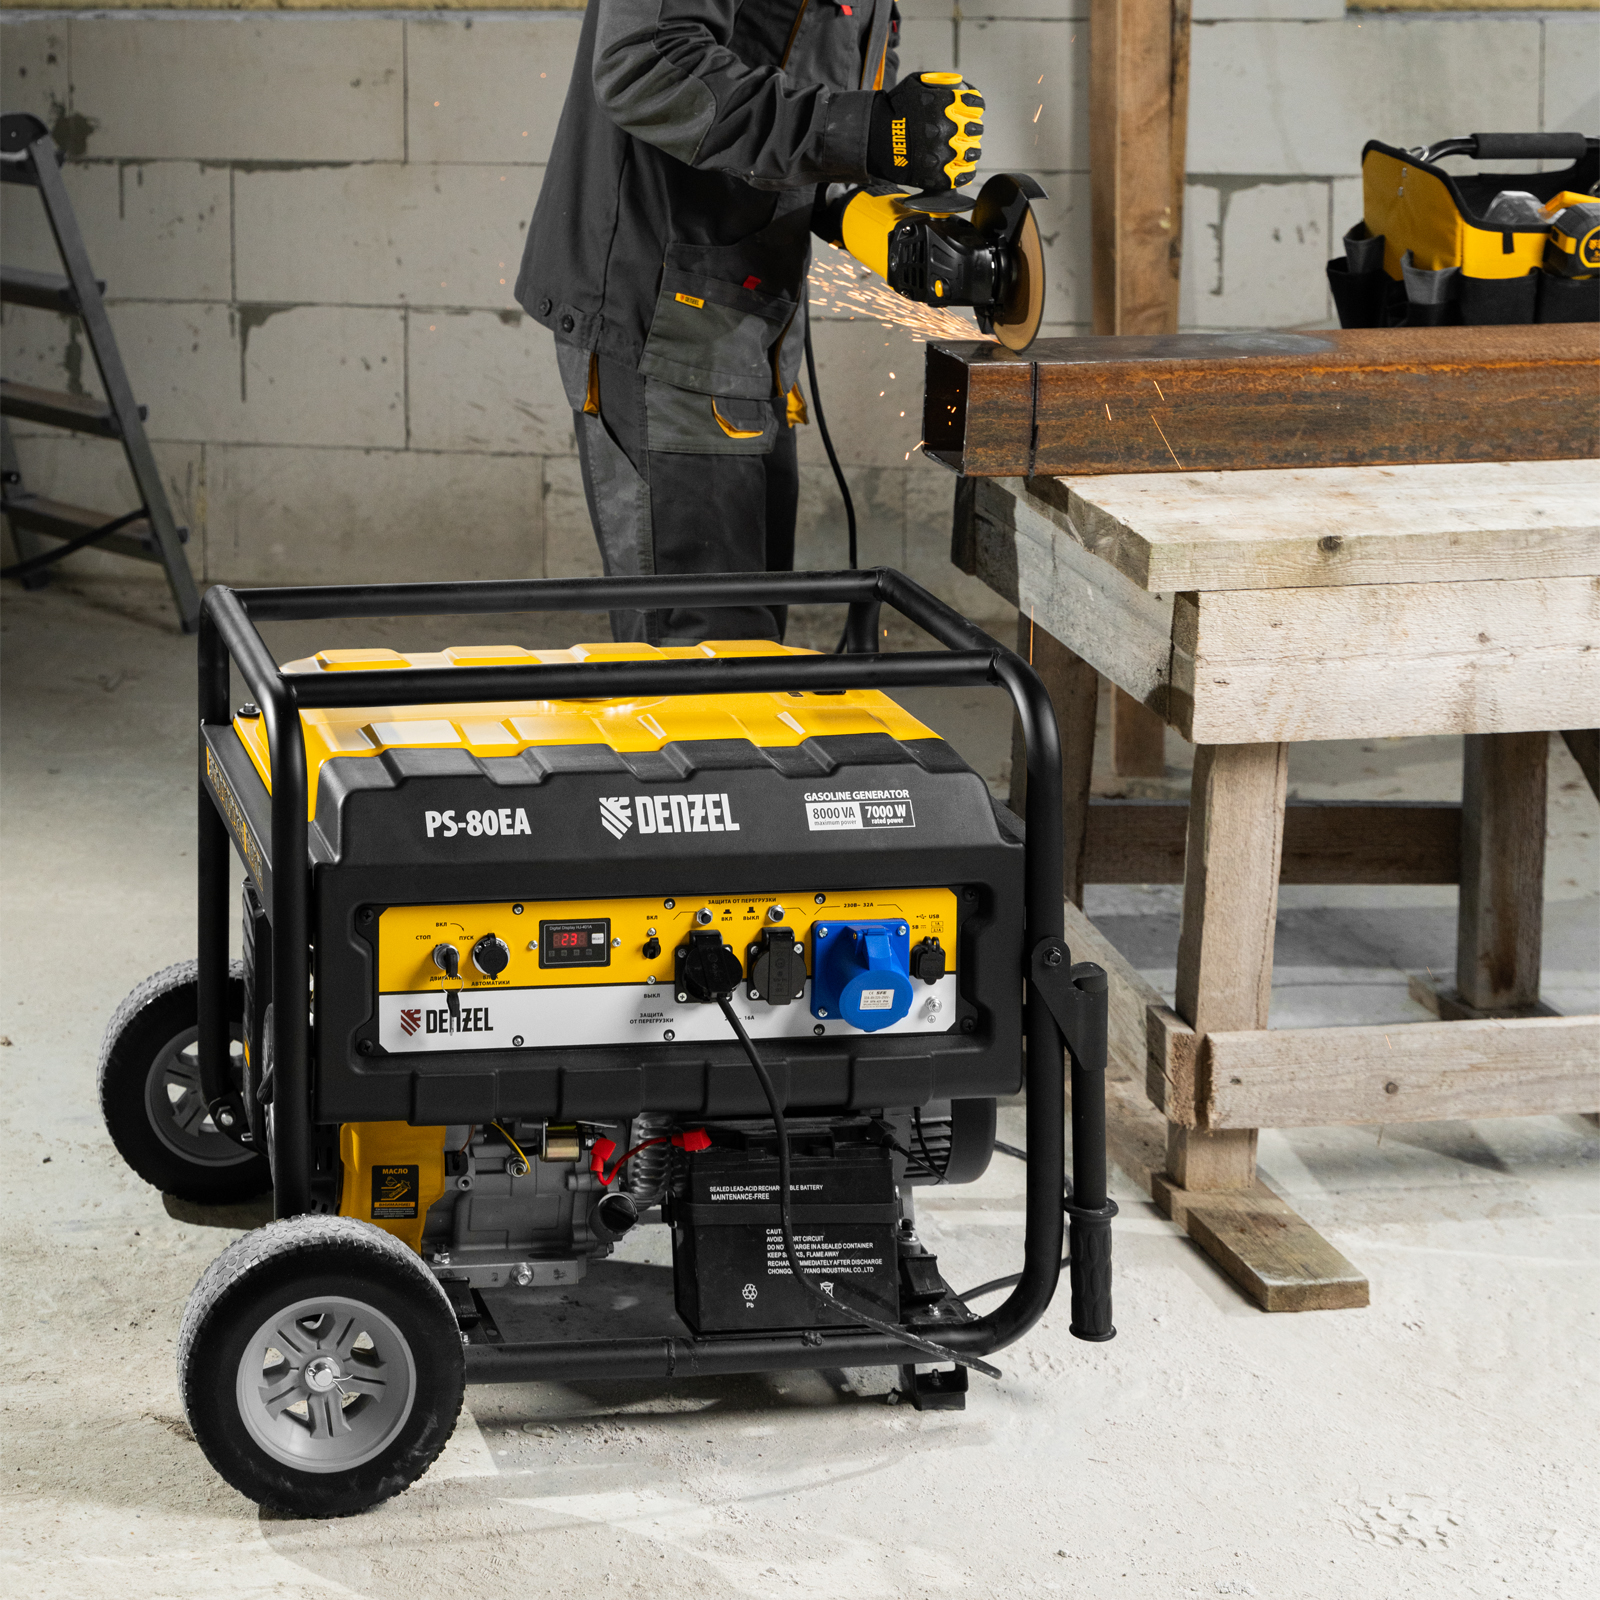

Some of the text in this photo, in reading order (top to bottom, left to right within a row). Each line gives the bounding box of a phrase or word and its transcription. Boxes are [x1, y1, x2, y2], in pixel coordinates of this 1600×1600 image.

[892, 117, 907, 155] DENZEL
[804, 789, 910, 801] GASOLINE GENERATOR
[636, 793, 740, 834] DENZEL
[813, 806, 856, 819] 8000 VA
[865, 804, 906, 818] 7000 W
[425, 808, 532, 838] PS-80EA
[561, 932, 578, 946] 23
